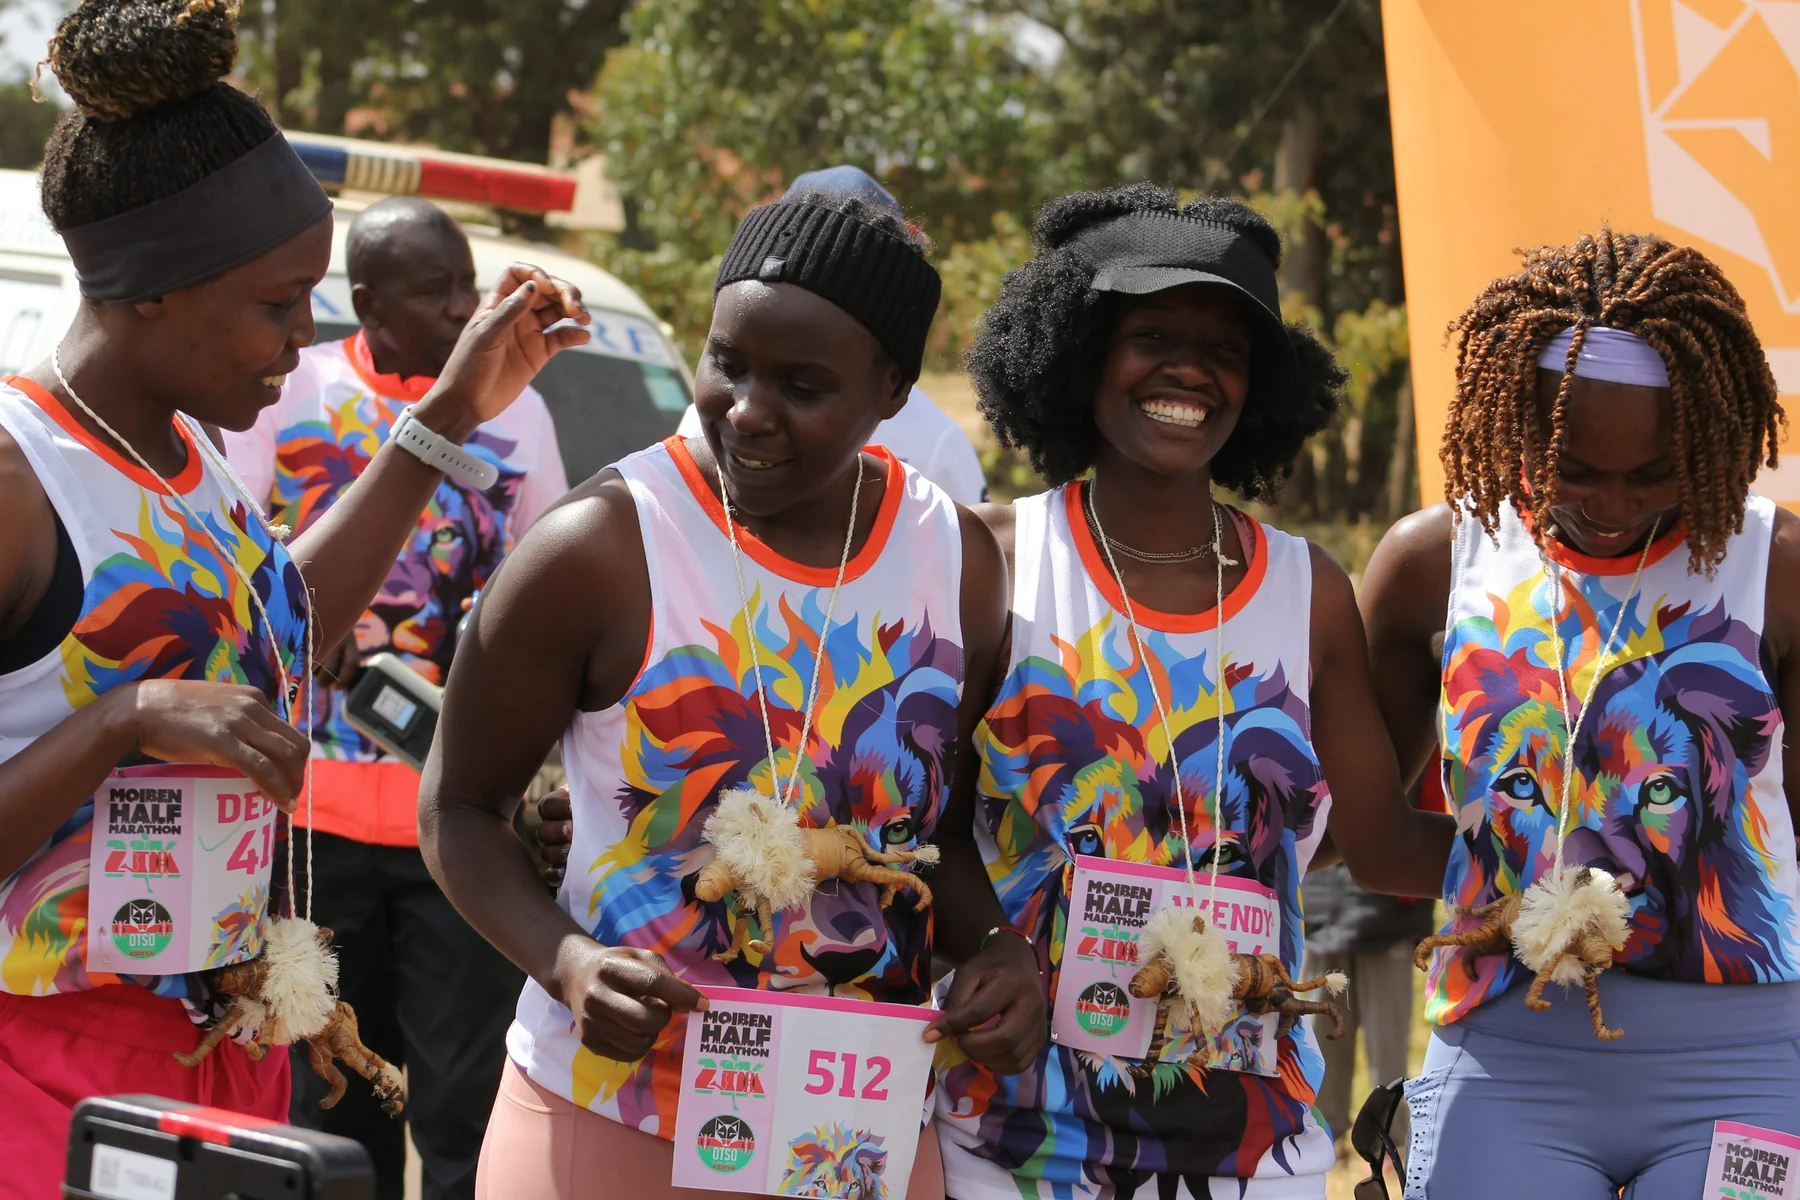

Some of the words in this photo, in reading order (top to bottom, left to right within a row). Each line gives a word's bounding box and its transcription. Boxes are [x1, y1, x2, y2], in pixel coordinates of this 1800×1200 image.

[110, 788, 182, 803] MOIBEN
[110, 804, 182, 824] HALF
[108, 824, 182, 835] MARATHON
[226, 822, 276, 875] 41
[1087, 880, 1153, 901] MOIBEN
[1084, 893, 1151, 919] HALF
[129, 933, 156, 947] OTSO
[702, 1010, 772, 1029] MOIBEN
[1090, 1012, 1114, 1027] OTSO
[700, 1024, 771, 1047] HALF
[699, 1043, 770, 1058] MARATHON
[804, 1049, 892, 1100] 512
[712, 1147, 738, 1162] OTSO
[1726, 1142, 1789, 1169] MOIBEN
[1723, 1155, 1787, 1186] HALF
[1722, 1173, 1783, 1196] MARATHON
